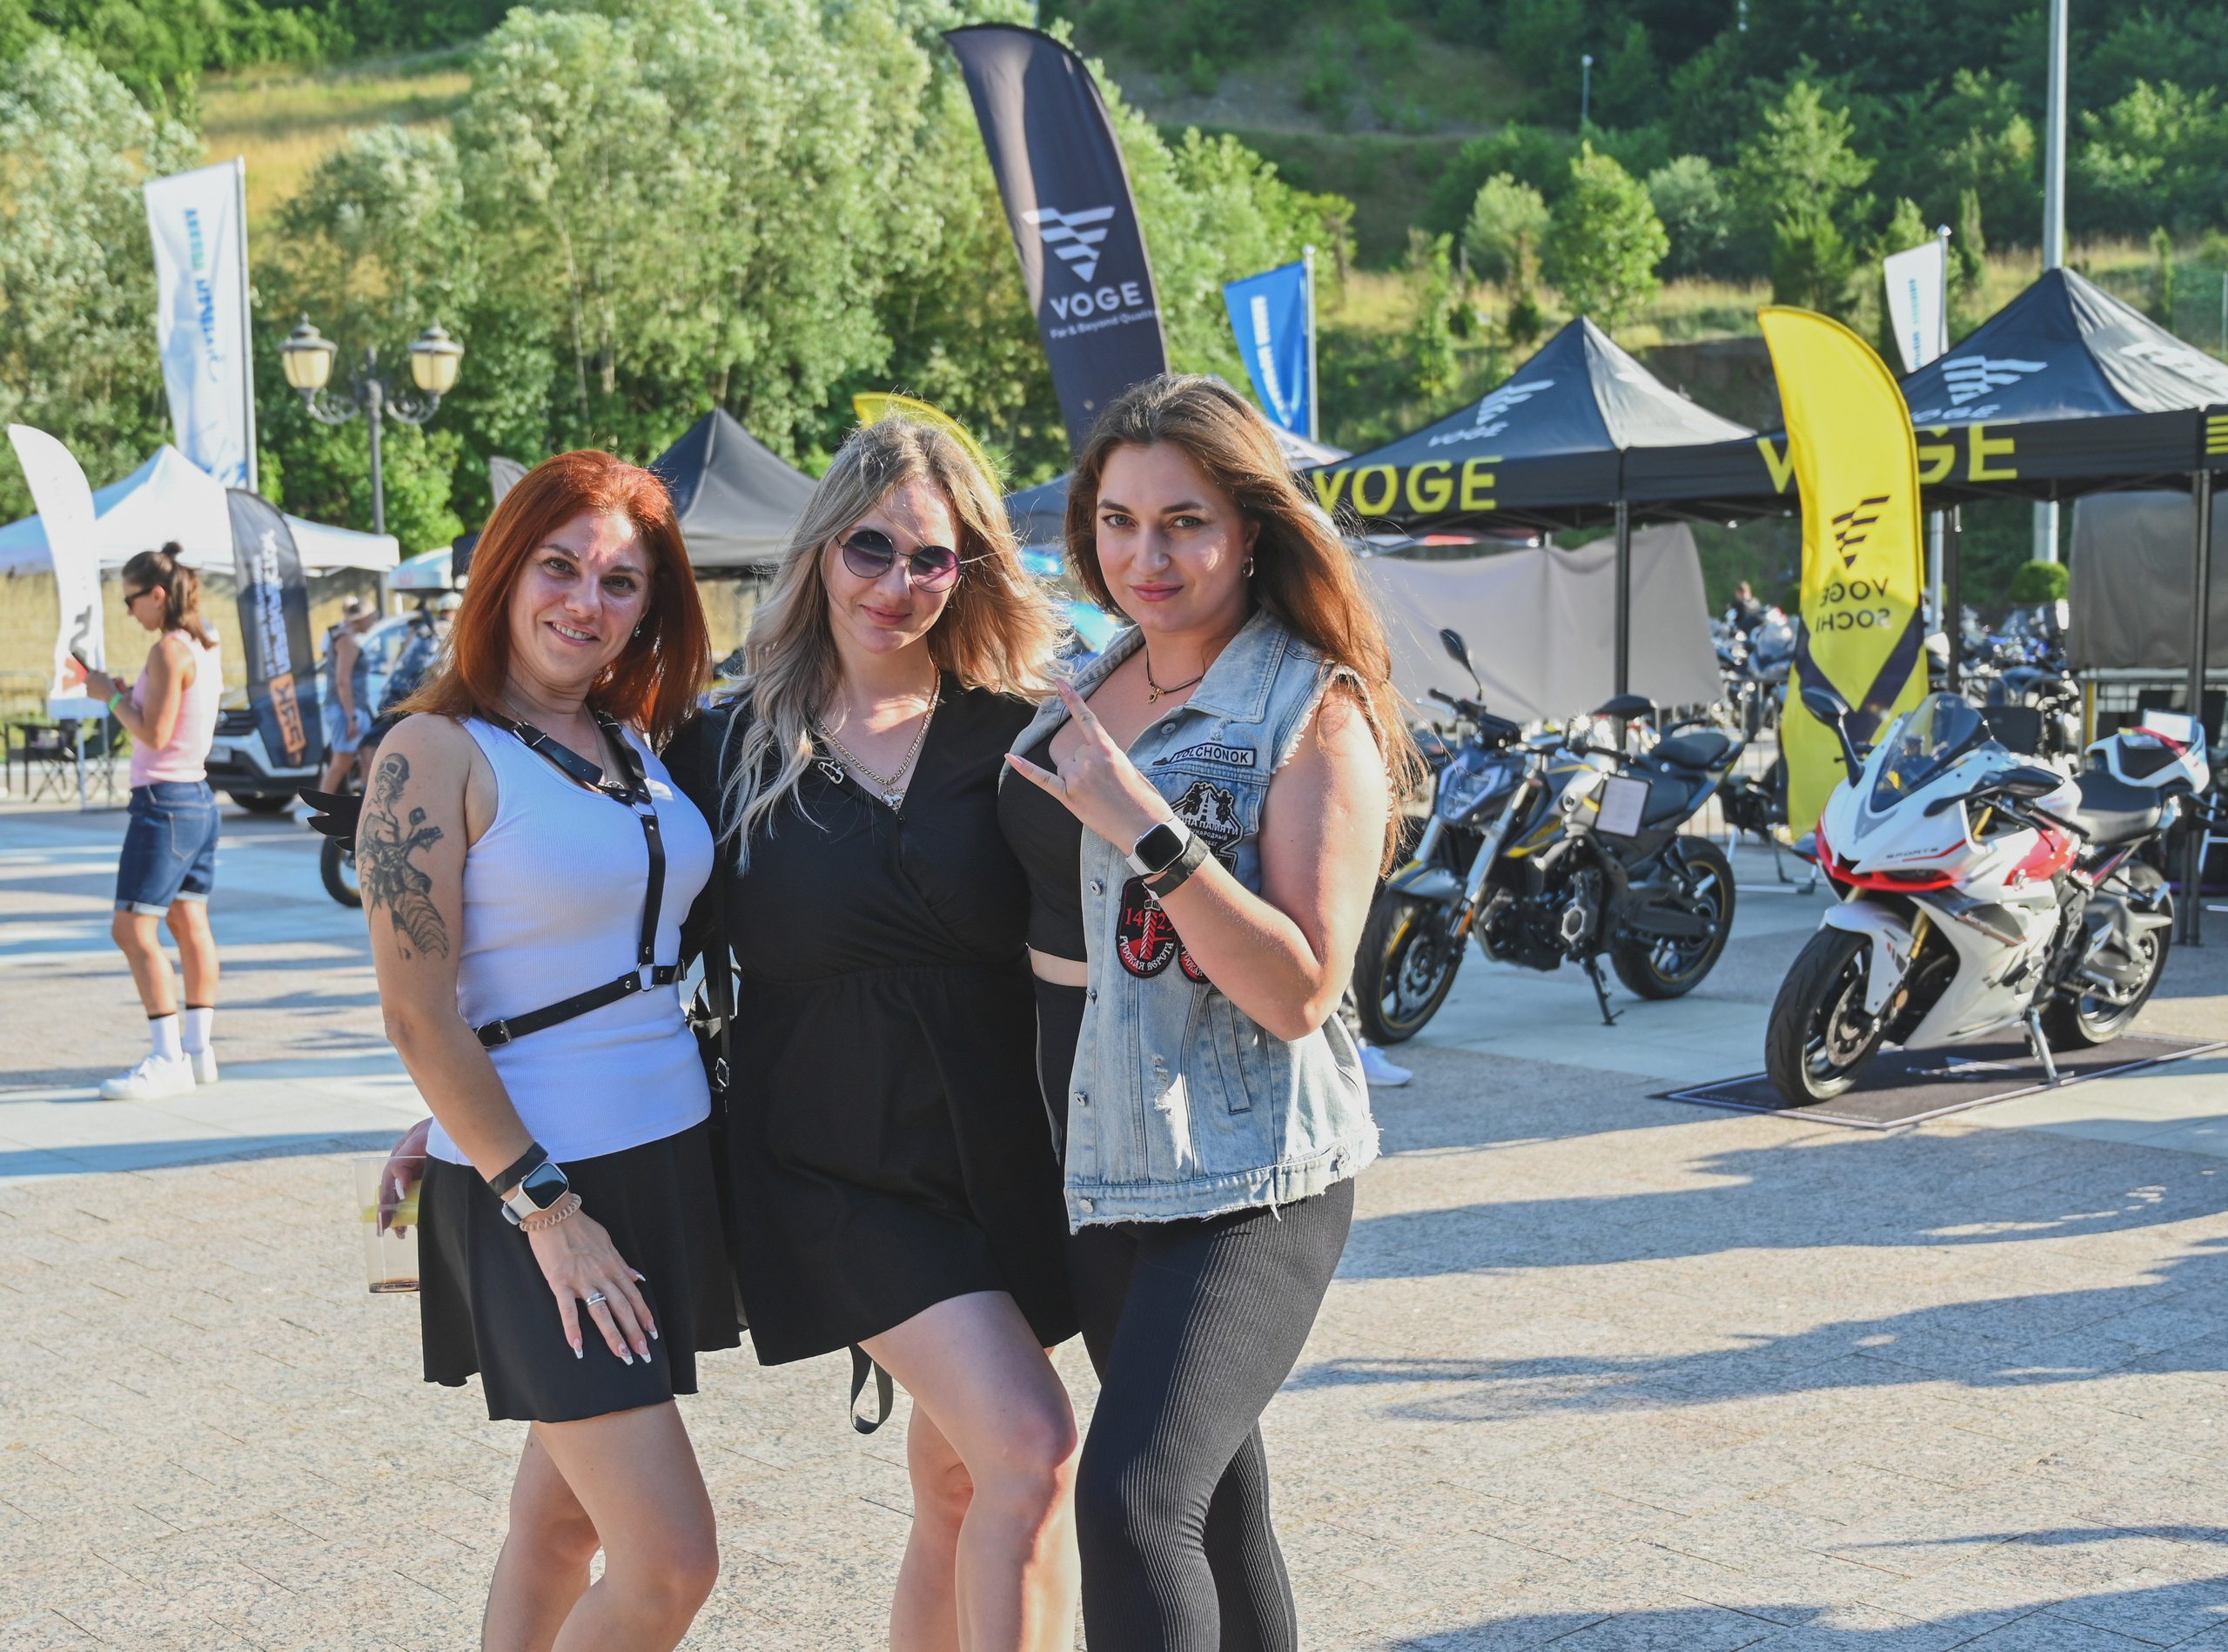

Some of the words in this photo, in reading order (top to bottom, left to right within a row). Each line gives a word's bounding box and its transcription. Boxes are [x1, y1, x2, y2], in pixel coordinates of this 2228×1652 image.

[1050, 280, 1144, 320] VOGE
[1077, 316, 1119, 334] Beyond
[1909, 404, 2002, 423] OGE
[1428, 420, 1510, 447] VOGE
[1756, 421, 2018, 495] VGE
[1312, 455, 1506, 517] VOGE
[1176, 746, 1249, 763] VOLCHONOK
[1198, 820, 1238, 836] ПАМЯТИ
[1119, 935, 1145, 971] РУССКАЯ
